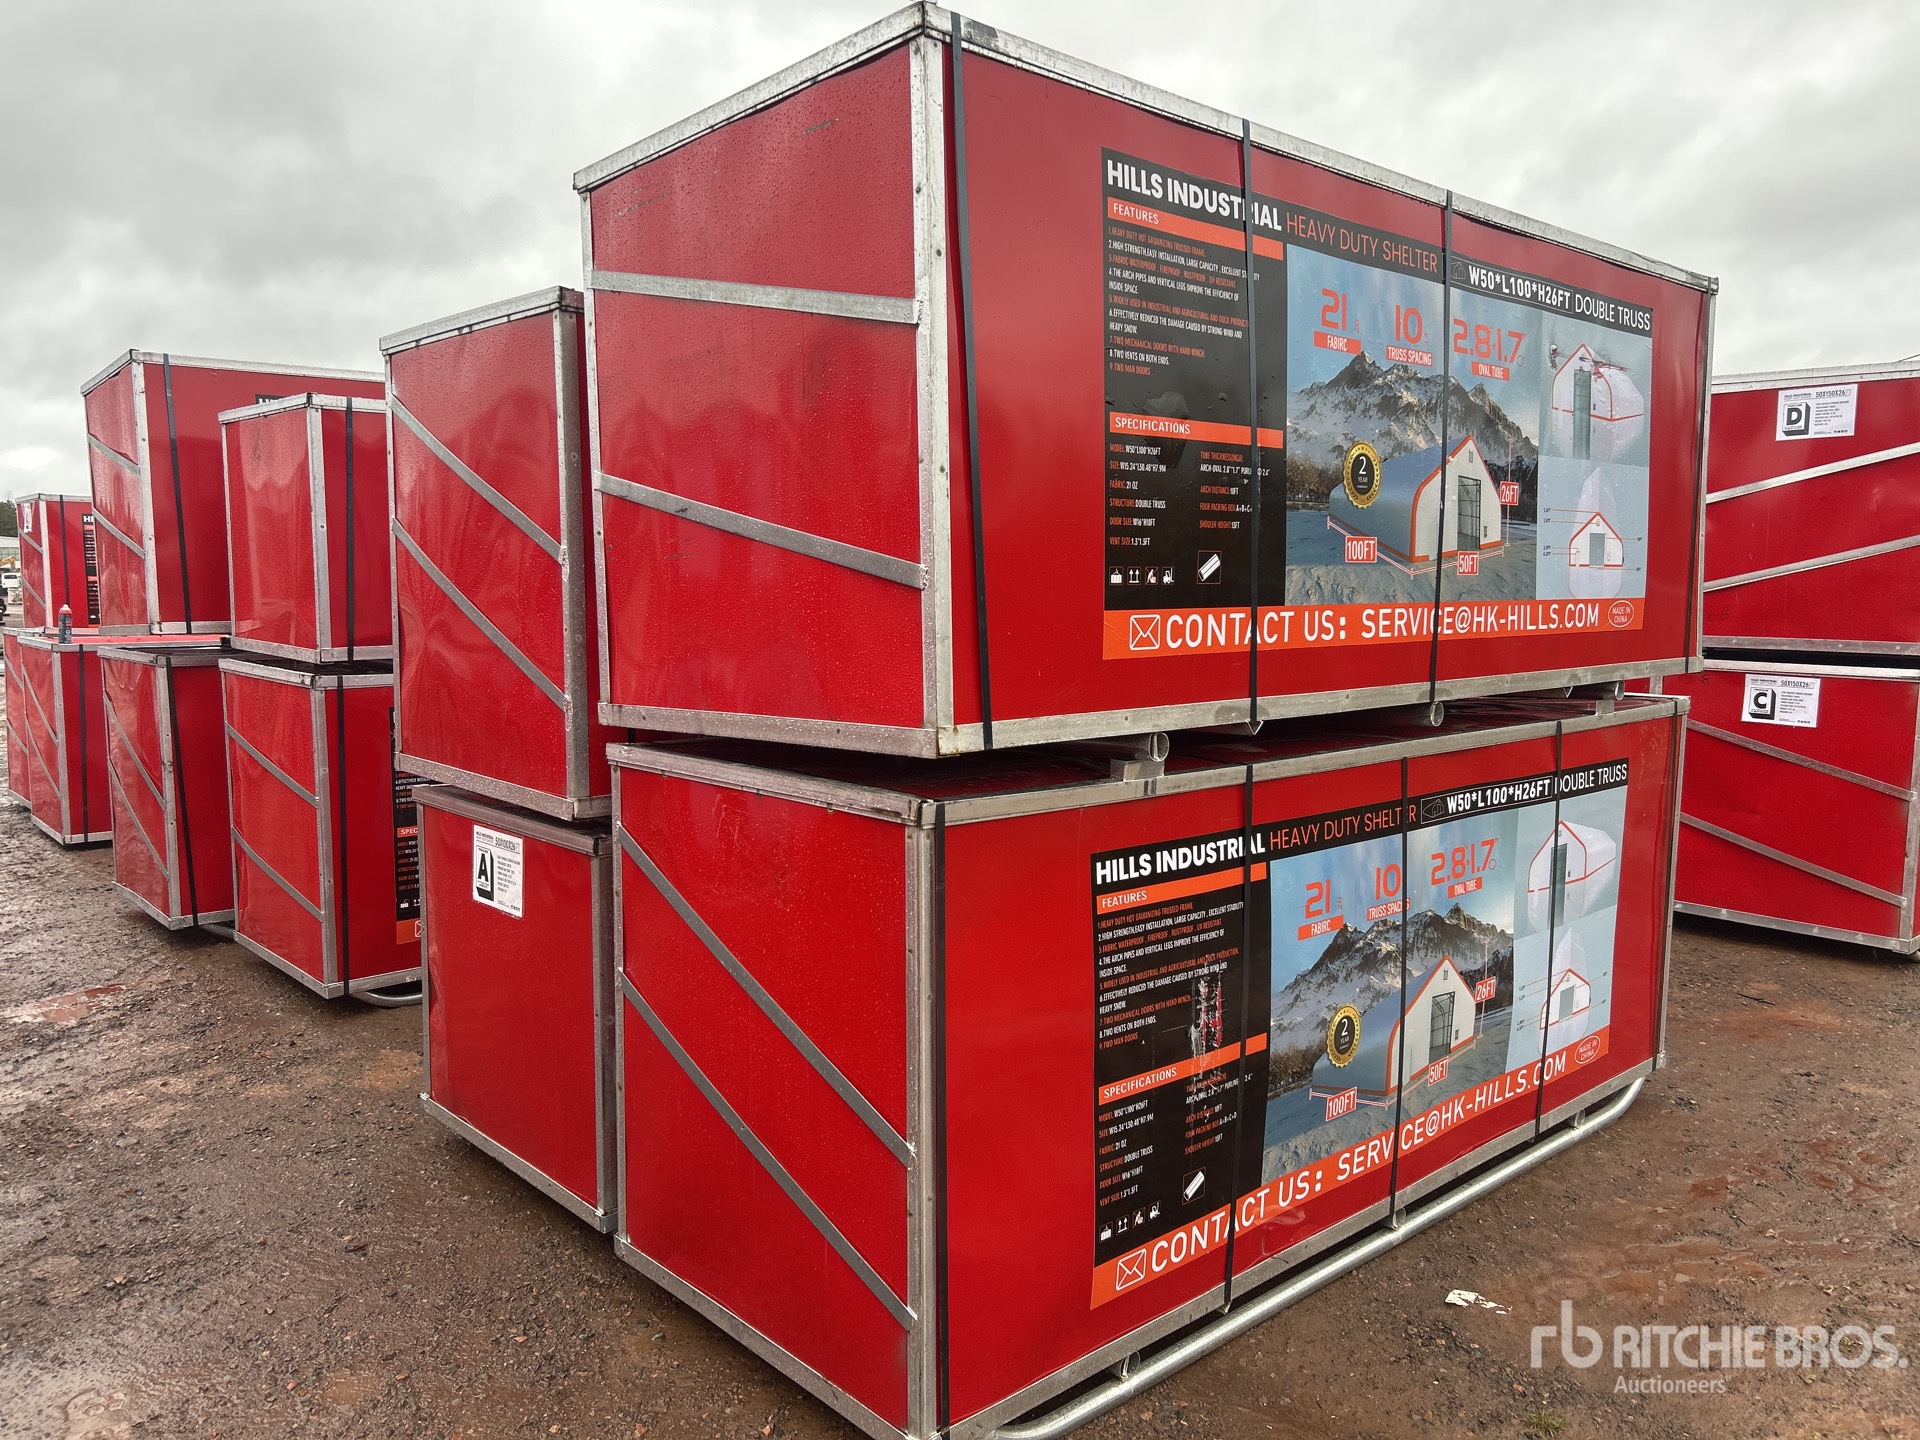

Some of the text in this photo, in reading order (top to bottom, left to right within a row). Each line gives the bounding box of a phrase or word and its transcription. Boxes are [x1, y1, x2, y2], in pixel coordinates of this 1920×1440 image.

[1108, 159, 1163, 198] HILLS
[1286, 212, 1336, 245] HEAVY
[1340, 229, 1378, 256] DUTY
[1382, 240, 1437, 273] SHELTER
[1114, 202, 1159, 224] FEATURES
[1186, 257, 1198, 268] LARGE
[1109, 281, 1123, 292] INSIDE
[1123, 271, 1134, 281] ARCH
[1135, 273, 1146, 283] PIPES
[1148, 276, 1156, 285] AND
[1157, 278, 1176, 289] VERTICAL
[1177, 281, 1185, 290] LEGS
[1187, 283, 1203, 294] IMPROVE
[1213, 288, 1233, 300] EFFICIENCY
[1234, 293, 1239, 301] OF
[1321, 288, 1347, 331] 21
[1575, 293, 1614, 323] DOUBLE
[1618, 306, 1650, 330] TRUSS
[1110, 322, 1123, 332] HEAVY
[1140, 314, 1158, 325] REDUCED
[1168, 319, 1184, 329] DAMAGE
[1186, 322, 1200, 332] CAUSED
[1201, 324, 1206, 333] BY
[1207, 325, 1222, 335] STRONG
[1224, 328, 1233, 337] WIND
[1234, 330, 1242, 339] AND
[1395, 304, 1422, 344] 10
[1327, 335, 1347, 351] FABIRC
[1125, 351, 1138, 361] VENTS
[1139, 353, 1144, 362] ON
[1146, 354, 1157, 363] BOTH
[1388, 347, 1432, 365] TRUSS SPACING
[1125, 365, 1135, 374] MAN
[1478, 364, 1503, 379] OVAL TUBE
[1786, 407, 1802, 425] D
[1116, 417, 1190, 434] SPECIFICATIONS
[1359, 456, 1366, 474] 2
[1501, 484, 1518, 503] 26FT
[1152, 500, 1165, 509] TRUSS
[1347, 540, 1375, 560] 100FT
[1459, 554, 1478, 573] 50FT
[1626, 606, 1630, 614] IN
[1166, 602, 1599, 648] CONTACT US: SERVICE@HK-HILLS.COM
[1753, 692, 1767, 709] C
[1096, 854, 1152, 885] HILLS
[1270, 823, 1320, 850] HEAVY
[1325, 815, 1360, 840] DUTY
[1364, 805, 1416, 831] SHELTR
[1598, 763, 1628, 785] TRUSS
[478, 853, 489, 882] A
[1376, 864, 1401, 900] 10
[1454, 879, 1476, 896] OVAL TUBE
[1102, 890, 1147, 909] FEATURES
[1305, 879, 1331, 919] 21
[1174, 914, 1186, 925] LARGE
[1187, 910, 1205, 922] CAPACITY
[1209, 905, 1226, 917] EXCELLENT
[1368, 905, 1386, 920] TRUSS
[1311, 920, 1331, 936] FABIRC
[1112, 952, 1123, 962] ARCH
[1124, 949, 1135, 959] PIPES
[1136, 947, 1144, 957] AND
[1145, 943, 1163, 954] VERTICAL
[1164, 940, 1173, 950] LEGS
[1174, 936, 1191, 948] IMPROVE
[1200, 930, 1219, 942] EFFICIENCY
[1220, 928, 1224, 937] OF
[1100, 967, 1113, 978] INSIDE
[1129, 983, 1146, 995] REDUCED
[1155, 976, 1171, 988] DAMAGE
[1172, 972, 1187, 983] CAUSED
[1188, 971, 1193, 979] BY
[1476, 980, 1495, 1001] 26FT
[1100, 1004, 1112, 1014] HEAVY
[1114, 1024, 1126, 1035] VENTS
[1127, 1022, 1133, 1031] ON
[1134, 1019, 1144, 1029] BOTH
[1342, 1019, 1348, 1036] 2
[1340, 1036, 1349, 1044] YEAR
[1579, 1039, 1597, 1054] MADE IN
[1581, 1049, 1594, 1060] CHINA
[1430, 1060, 1447, 1083] 50FT
[1104, 1067, 1177, 1098] SPECIFICATIONS
[1329, 1091, 1355, 1117] 100FT
[1152, 1051, 1566, 1272] CONTACT US: SERVCE@HK-HILLS.COM
